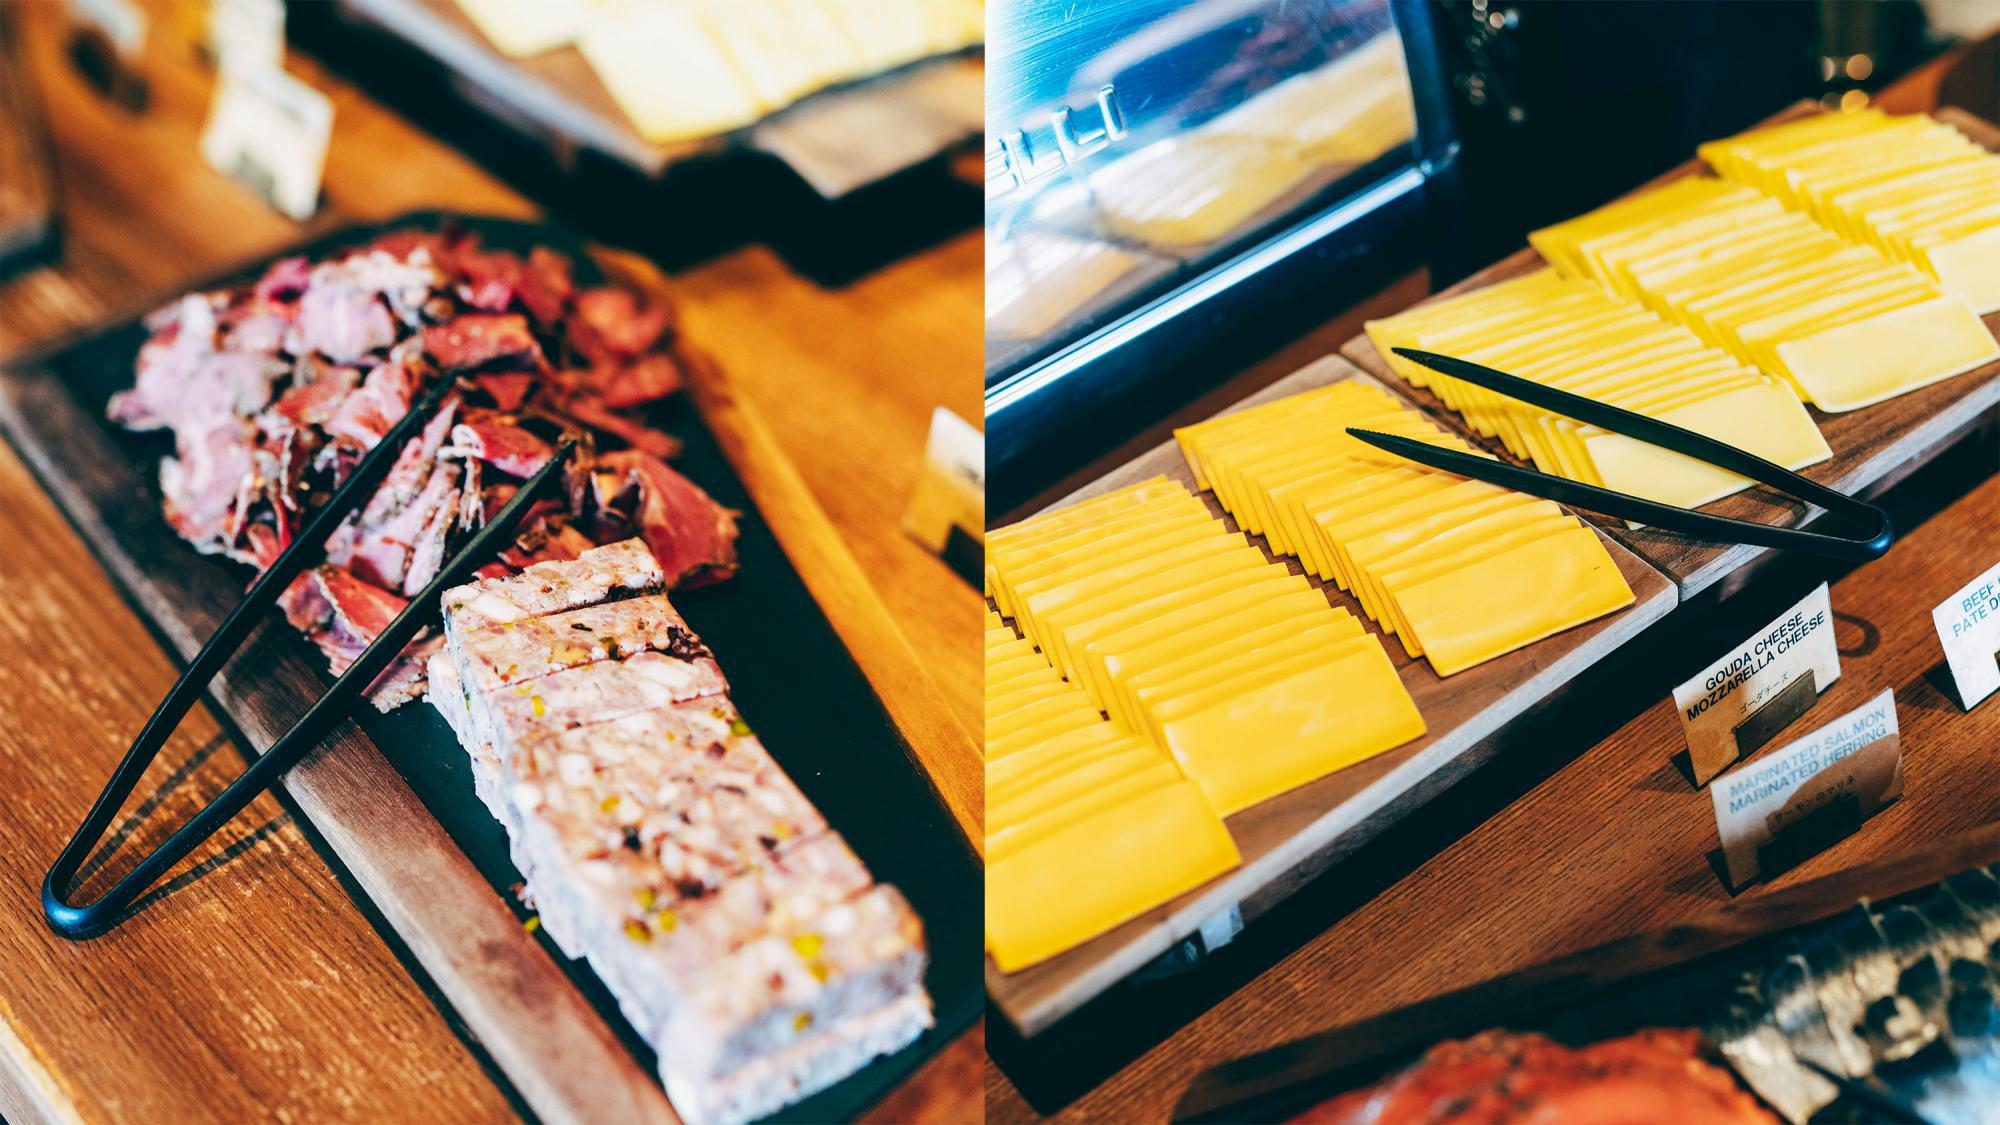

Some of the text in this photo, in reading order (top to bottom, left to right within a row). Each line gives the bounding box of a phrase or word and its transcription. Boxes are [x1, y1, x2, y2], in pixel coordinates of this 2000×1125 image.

[1952, 592, 2000, 638] PATE D
[1962, 583, 1994, 612] BEEF
[1686, 610, 1825, 721] MOZZARELLA CHEESE
[1705, 611, 1804, 691] GOUDA CHEESE
[1729, 707, 1886, 797] MARINATED SALMON
[1729, 724, 1887, 814] MARINATED HERRING
